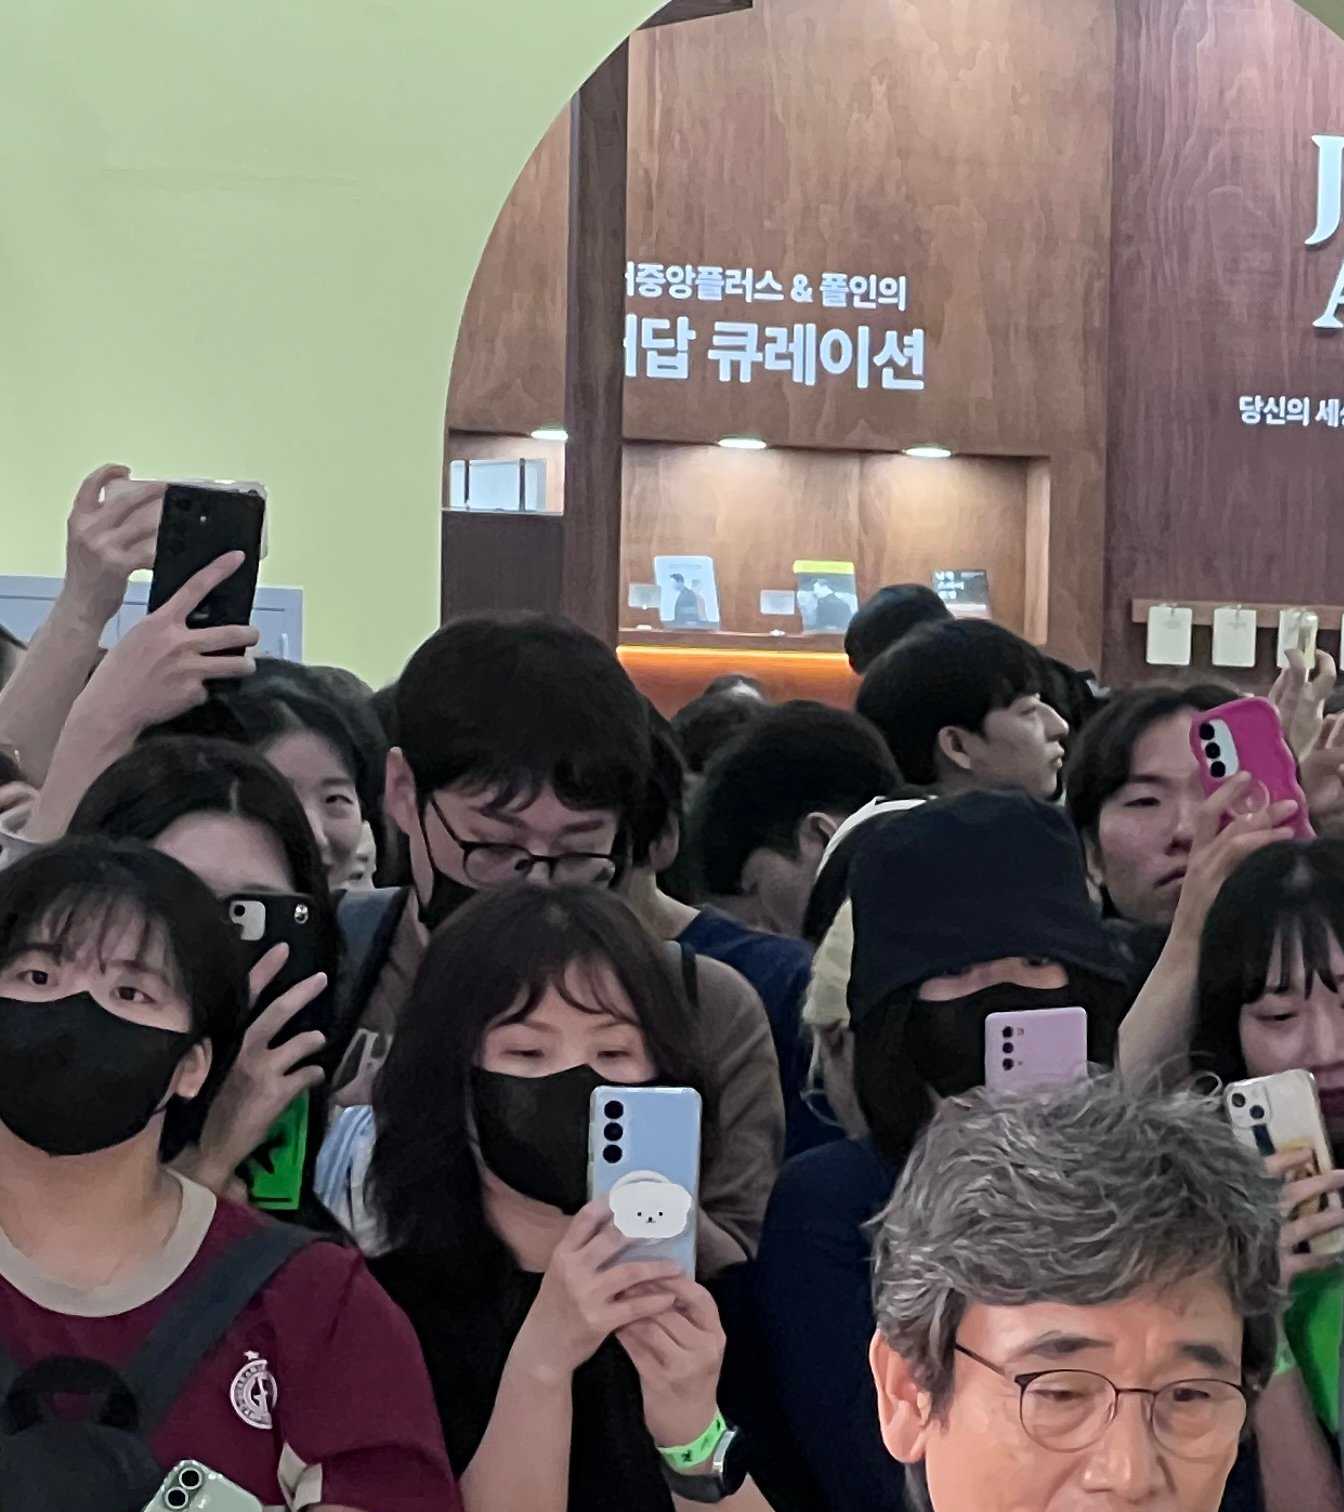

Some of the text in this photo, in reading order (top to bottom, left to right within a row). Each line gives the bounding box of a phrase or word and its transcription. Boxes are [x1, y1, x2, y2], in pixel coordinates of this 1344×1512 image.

[790, 273, 813, 303] &
[819, 272, 906, 311] 폴인의
[707, 322, 925, 390] 큐레이션
[1239, 395, 1310, 427] 당신의
